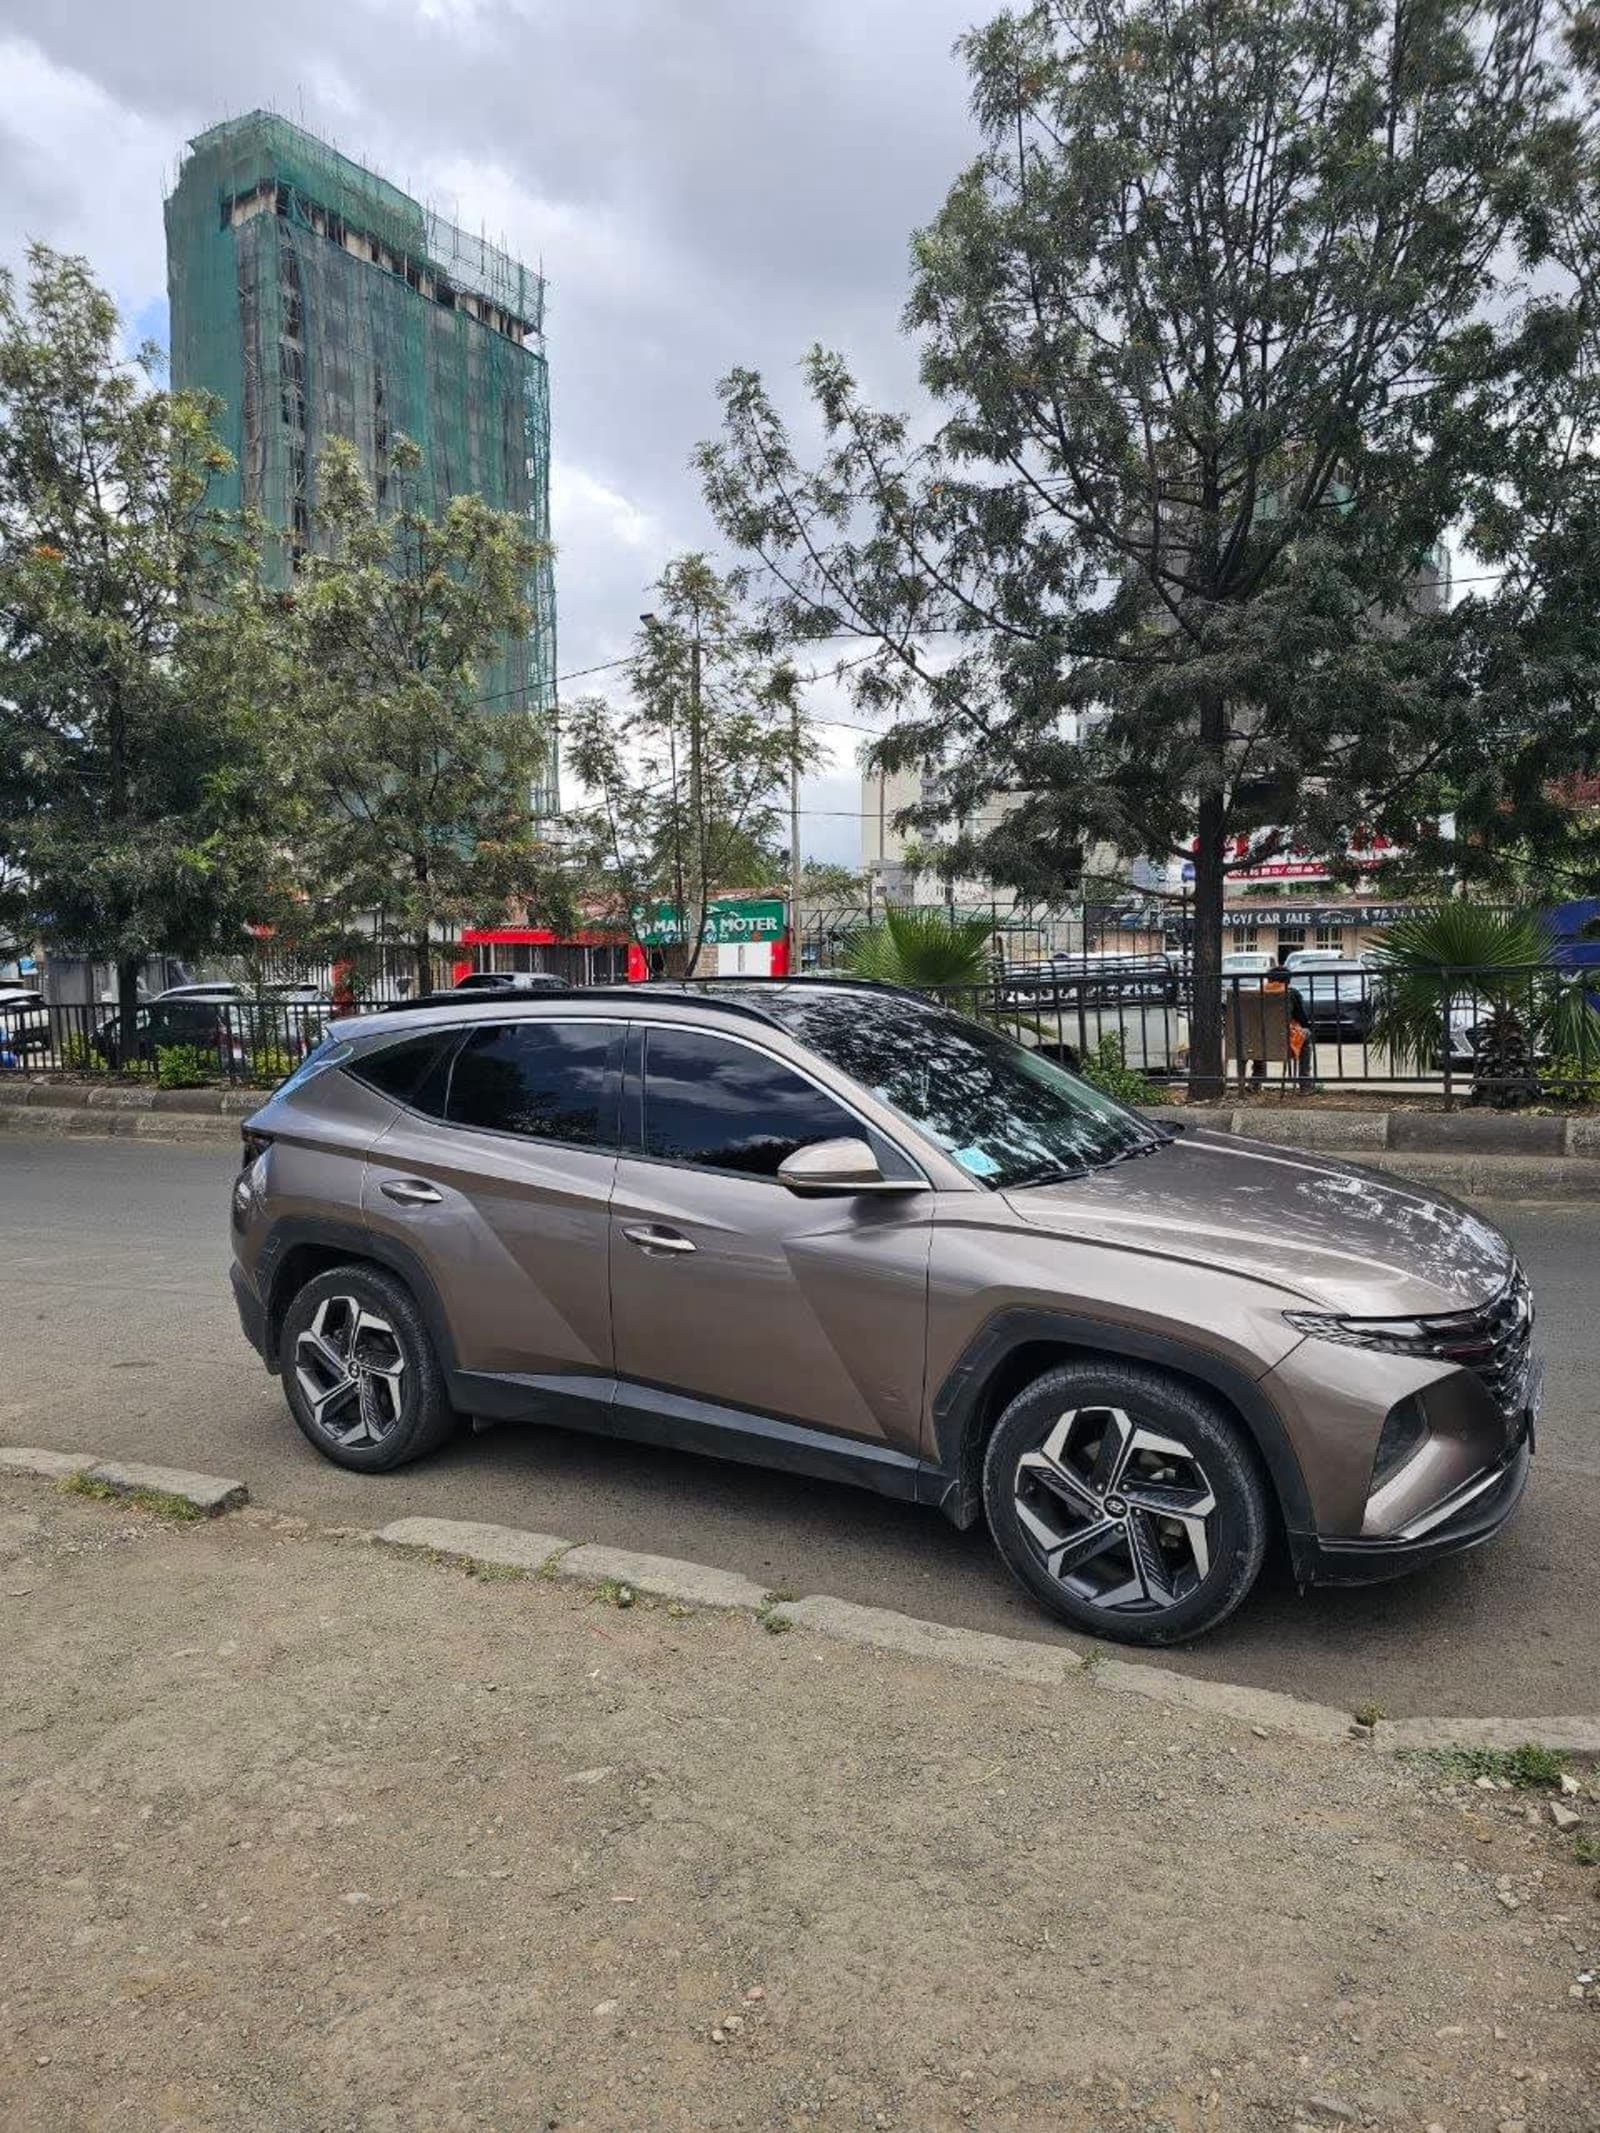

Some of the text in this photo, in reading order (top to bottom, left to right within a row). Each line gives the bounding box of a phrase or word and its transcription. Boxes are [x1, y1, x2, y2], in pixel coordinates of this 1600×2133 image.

[719, 916, 778, 932] MOTER
[1256, 912, 1281, 924] CAR
[1284, 912, 1312, 925] SALE
